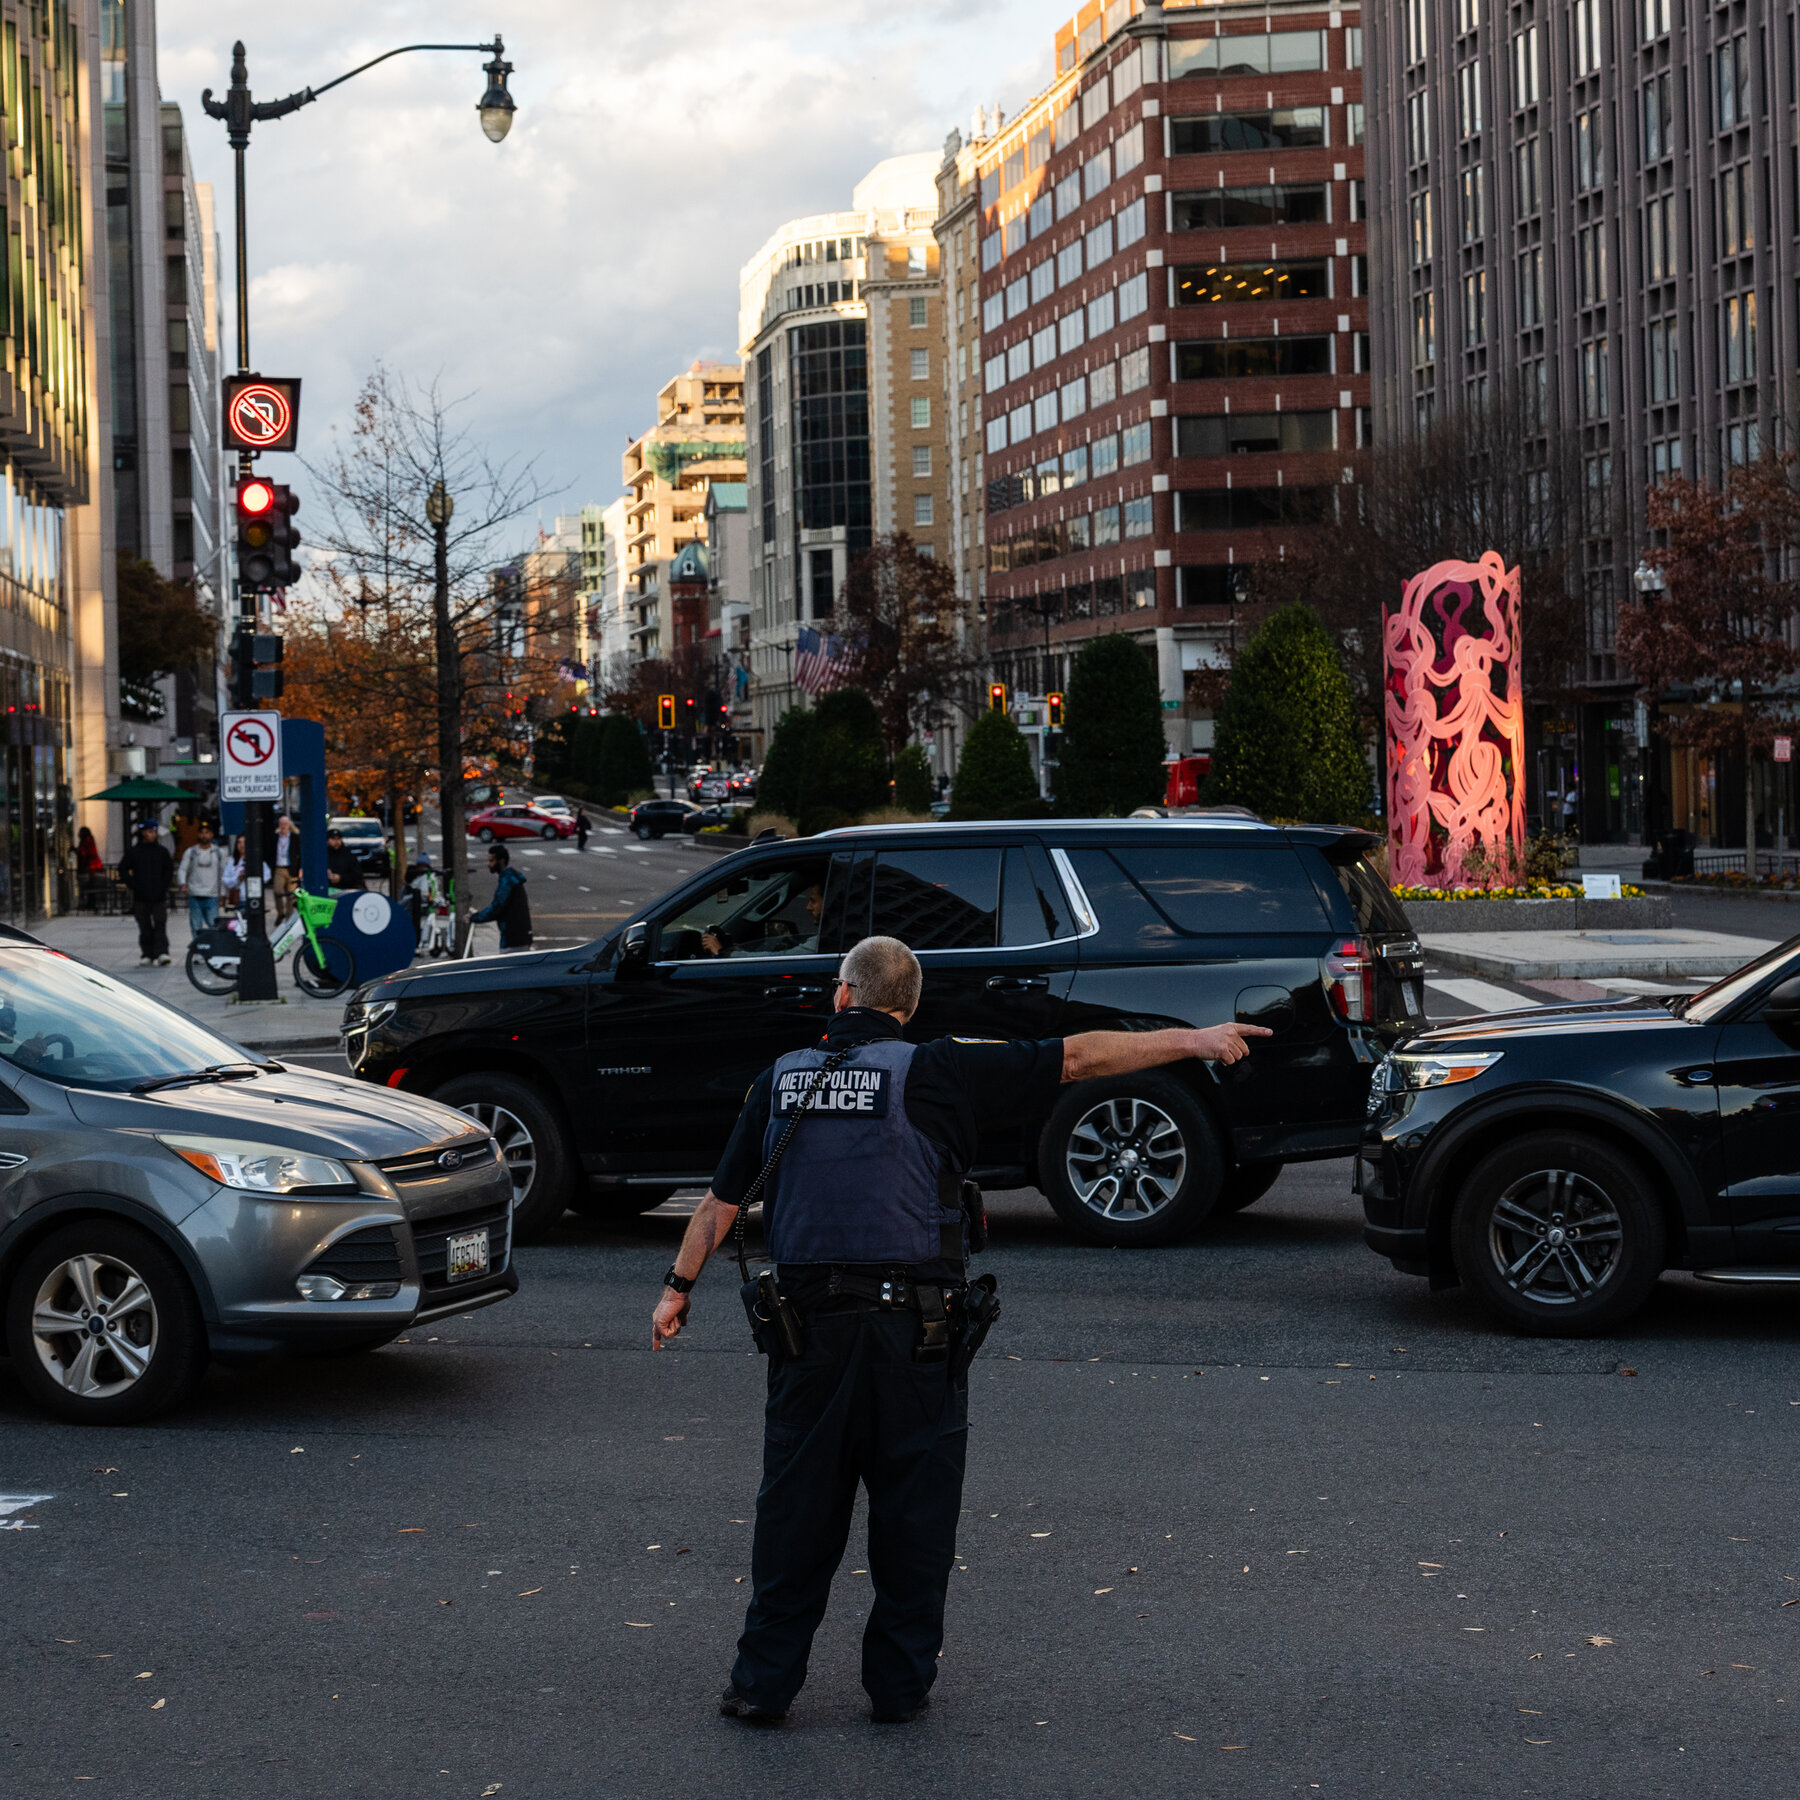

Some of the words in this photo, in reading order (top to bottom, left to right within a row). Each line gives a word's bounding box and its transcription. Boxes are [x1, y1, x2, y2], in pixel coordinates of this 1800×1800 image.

[225, 774, 251, 784] EXCEPT
[254, 774, 278, 783] BUSES
[228, 785, 242, 793] AND
[244, 784, 278, 793] TAXICABS
[597, 1066, 652, 1075] TAHOE
[780, 1090, 875, 1110] POLICE
